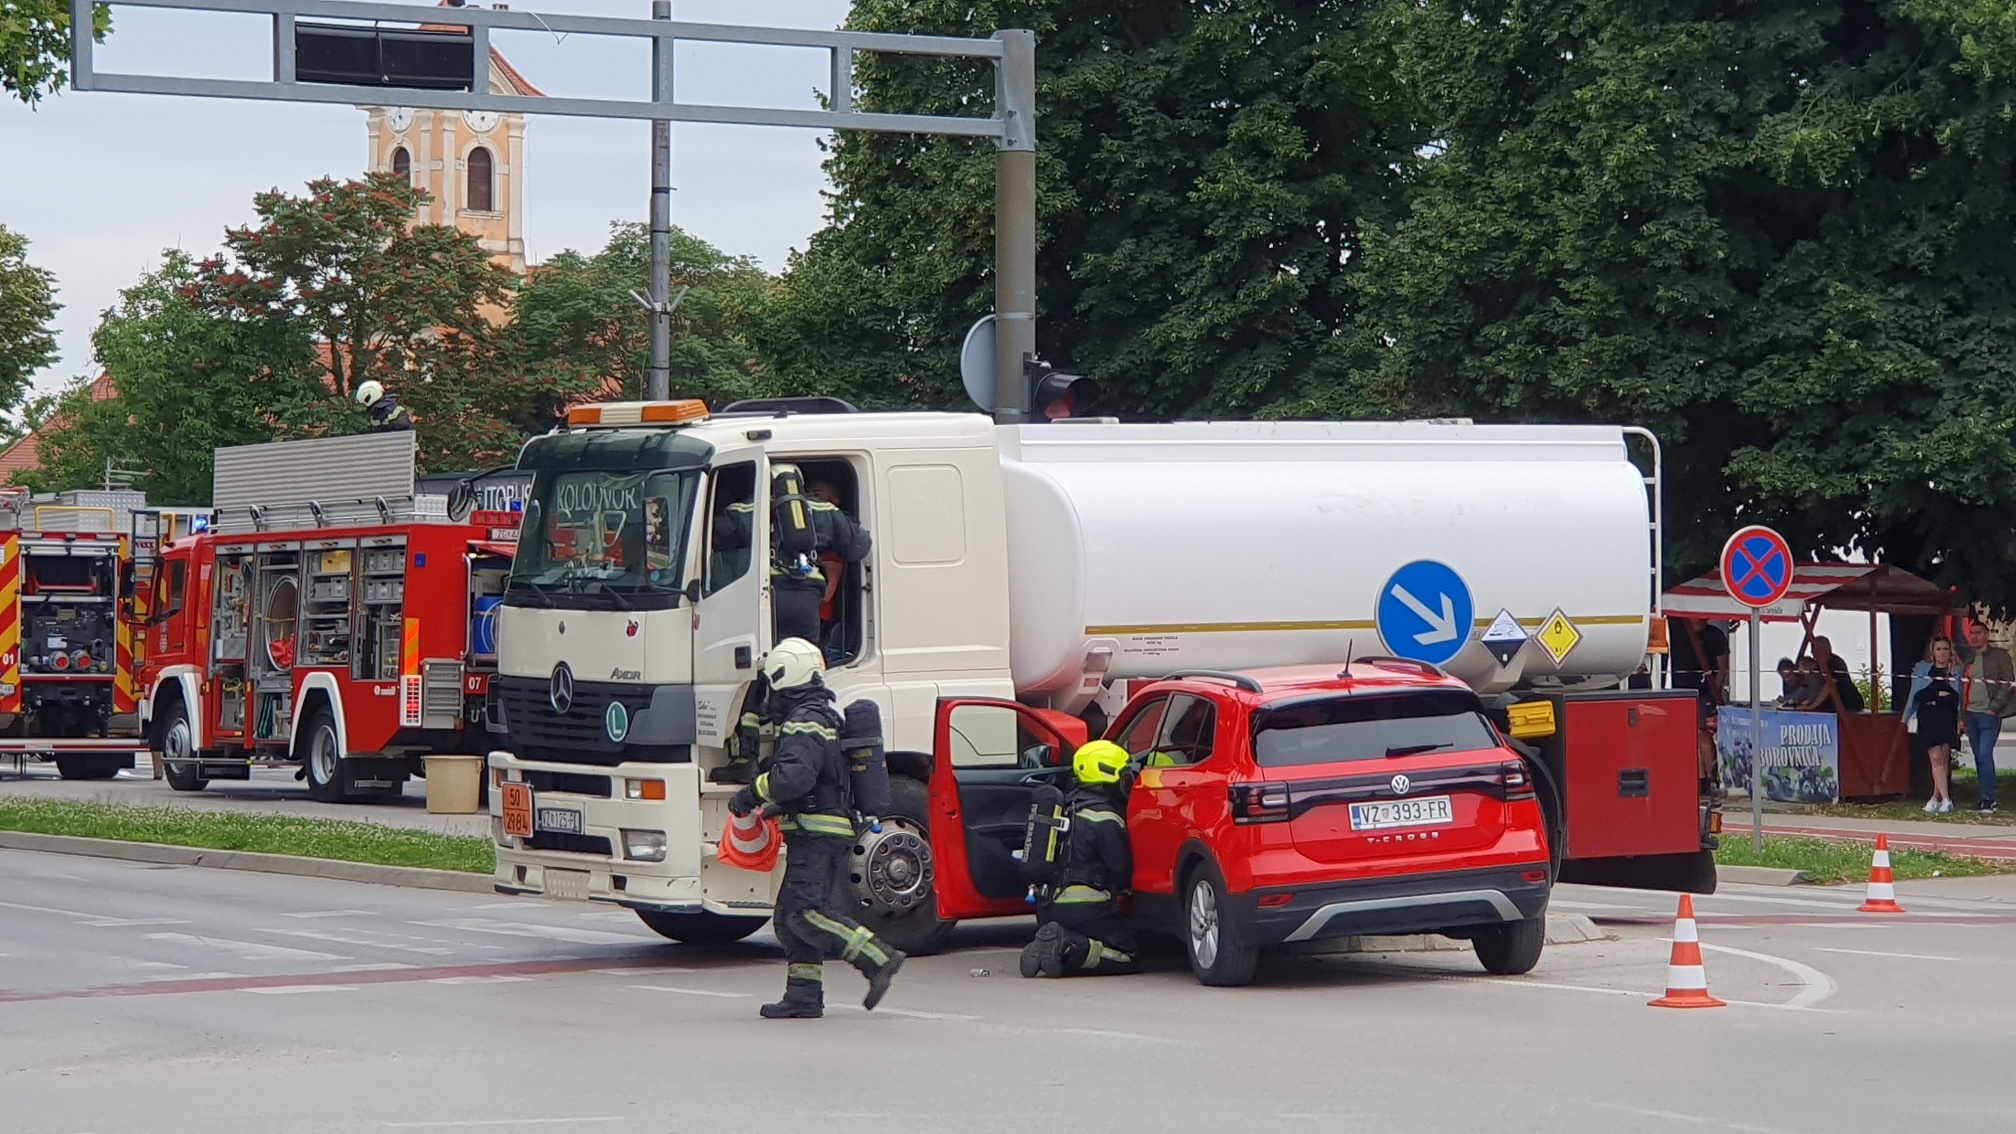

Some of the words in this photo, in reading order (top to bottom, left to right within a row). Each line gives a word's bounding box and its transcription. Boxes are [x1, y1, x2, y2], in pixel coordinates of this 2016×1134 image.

[2, 653, 14, 665] 01
[468, 677, 481, 690] 07
[612, 709, 622, 734] L
[1780, 724, 1832, 747] PRODAJA
[509, 788, 520, 806] 50
[1391, 800, 1449, 821] 393-FR
[506, 811, 528, 831] 2984
[1366, 831, 1439, 843] T-CROSS
